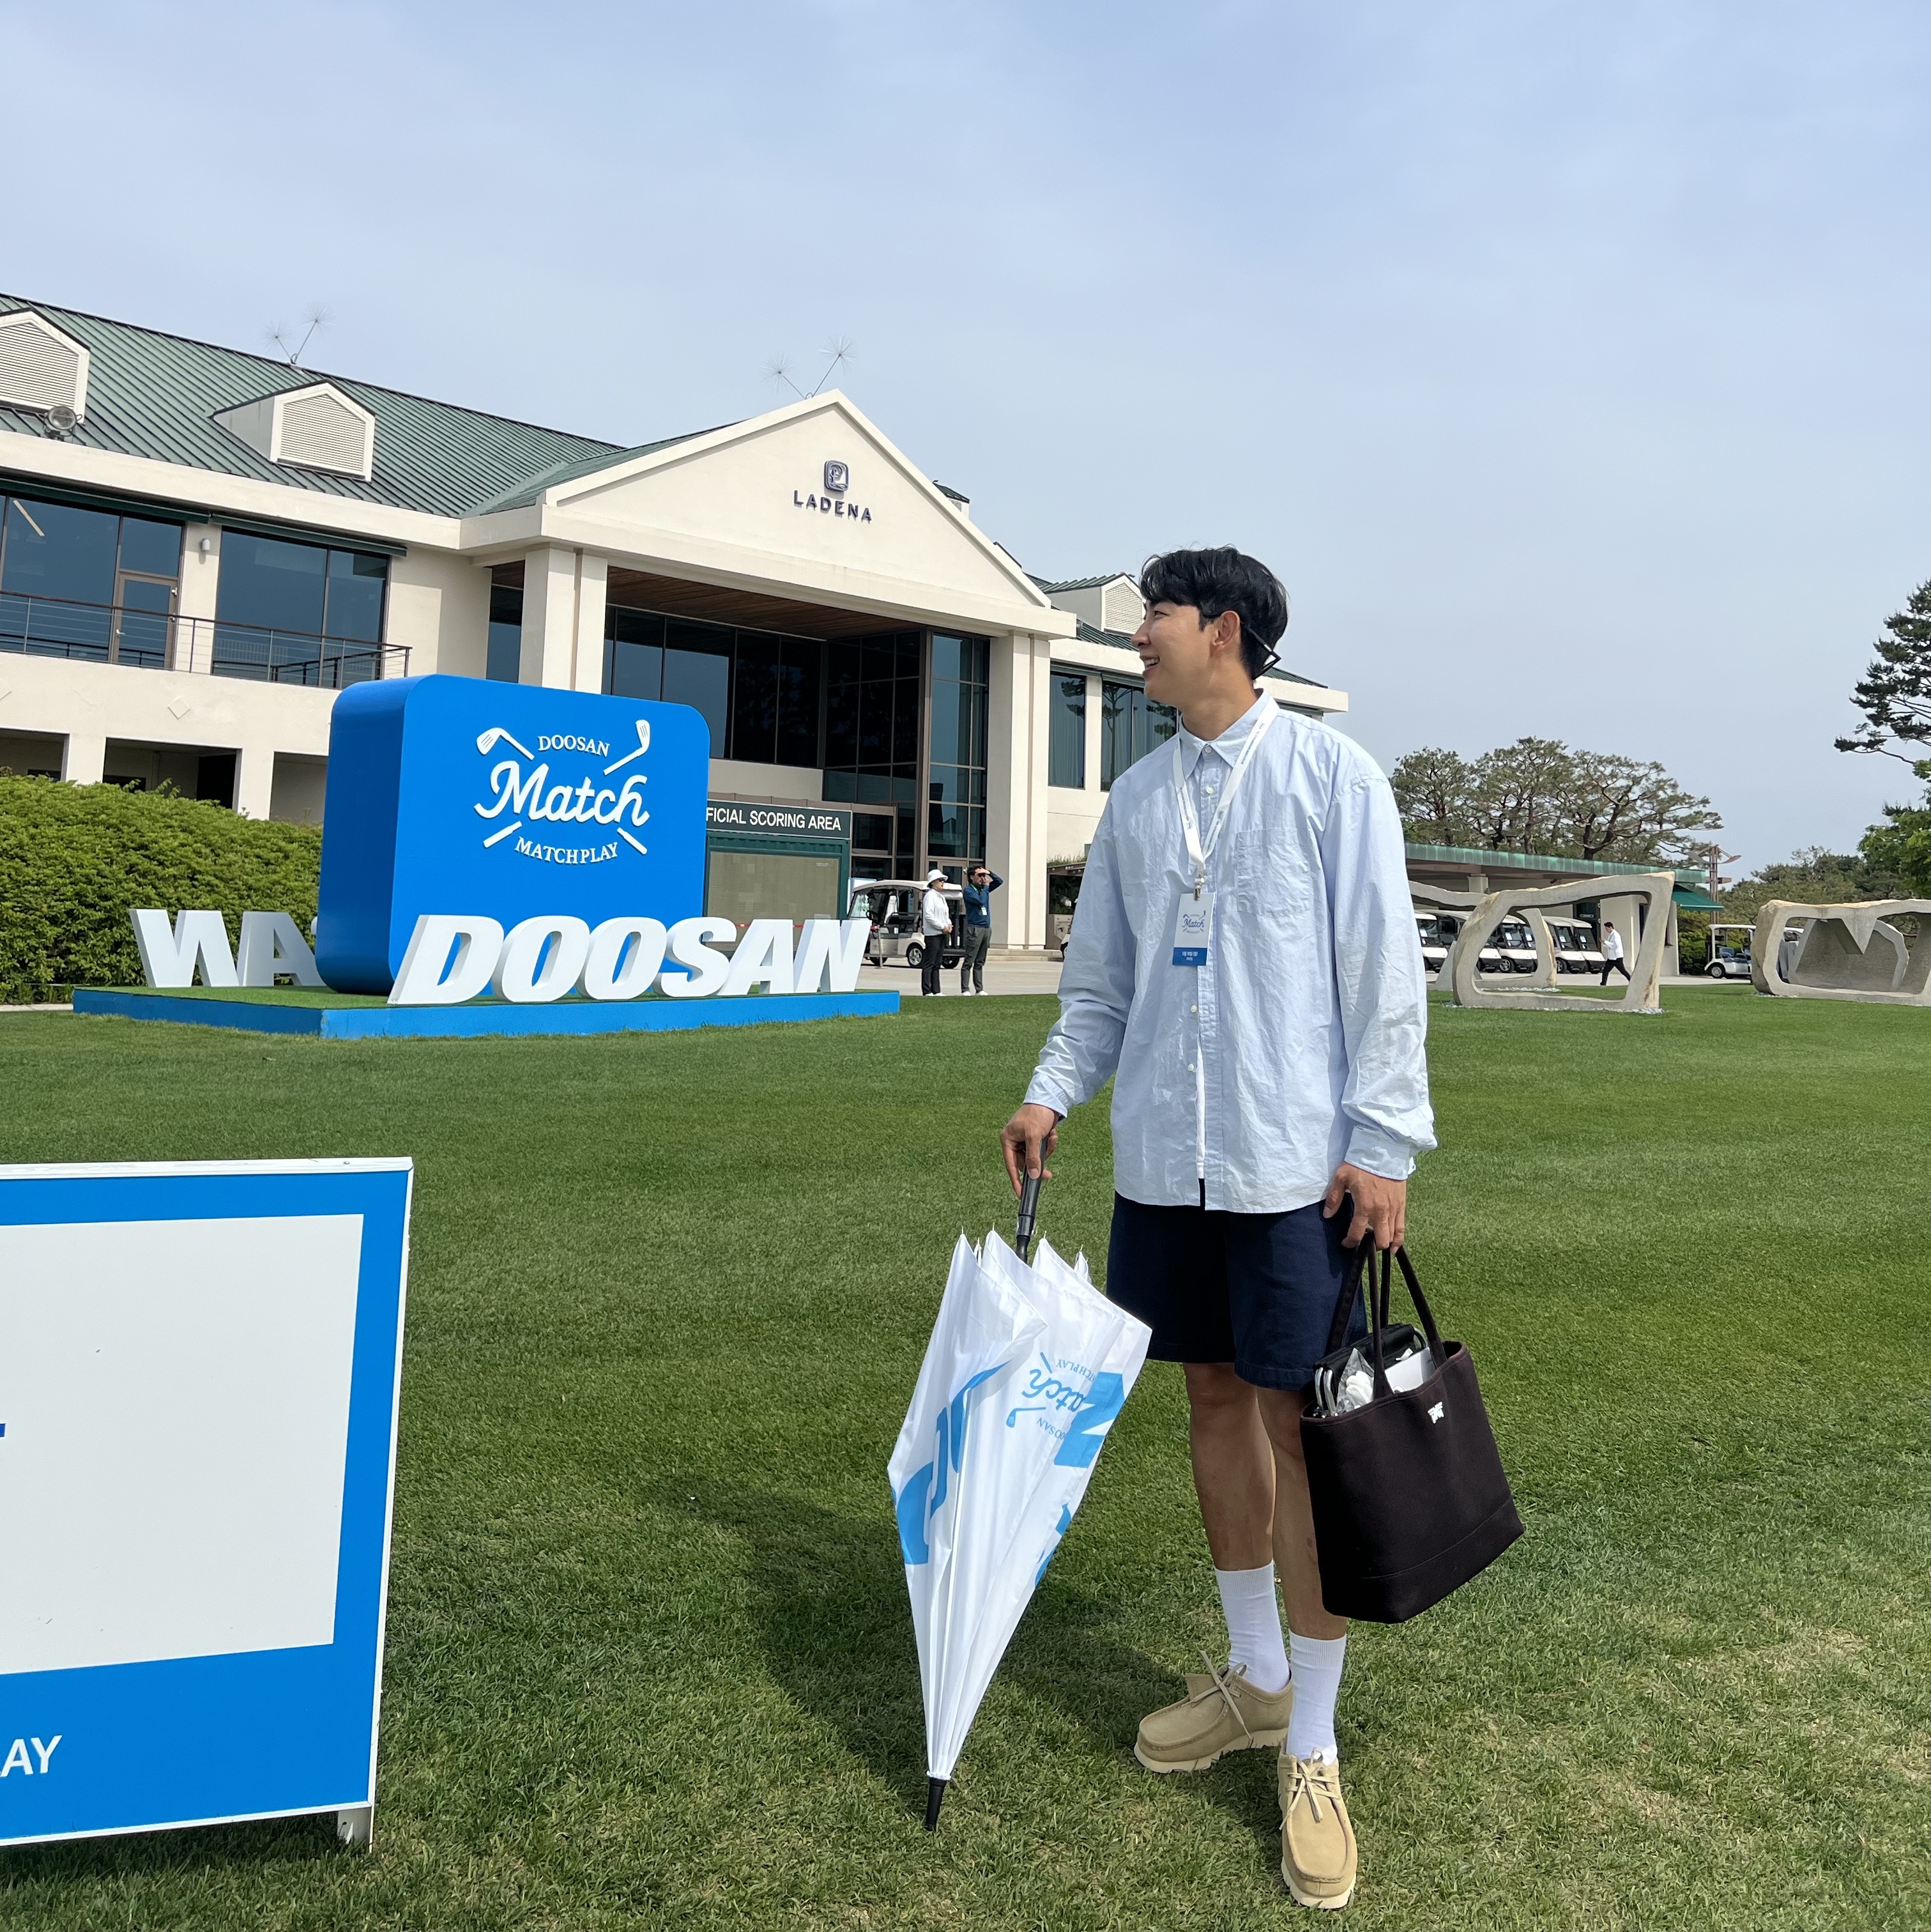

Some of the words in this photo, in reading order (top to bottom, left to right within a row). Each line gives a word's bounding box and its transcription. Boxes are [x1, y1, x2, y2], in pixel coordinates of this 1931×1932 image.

[794, 490, 872, 523] LADENA
[537, 735, 610, 757] DOOSAN
[473, 760, 650, 827] Match
[749, 810, 805, 829] SCORING
[808, 815, 841, 831] AREA
[514, 836, 618, 864] MATCHPLAY
[1182, 919, 1205, 928] Match
[130, 908, 326, 988] WA
[386, 914, 873, 1005] DOOSAN
